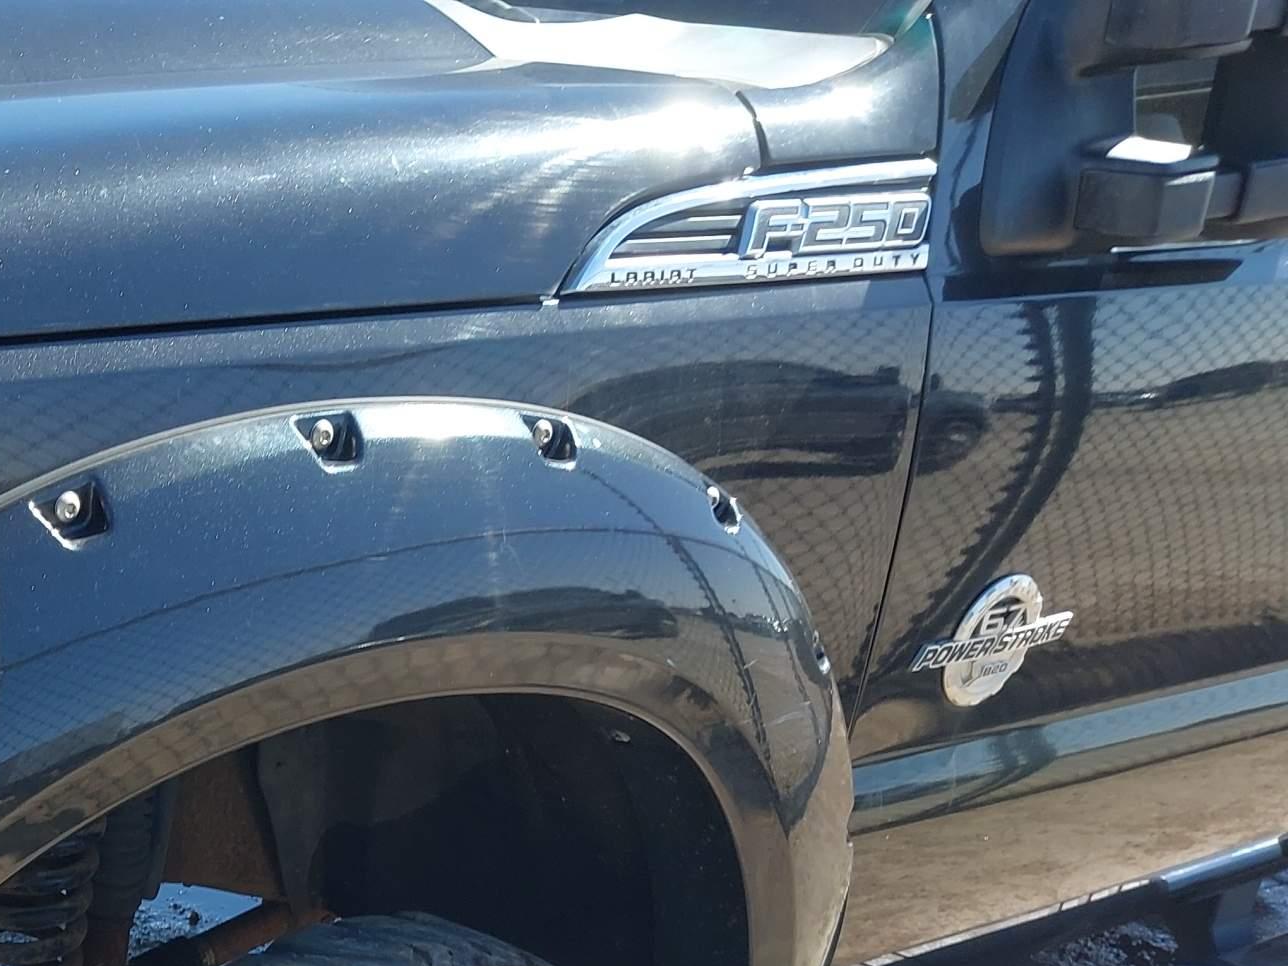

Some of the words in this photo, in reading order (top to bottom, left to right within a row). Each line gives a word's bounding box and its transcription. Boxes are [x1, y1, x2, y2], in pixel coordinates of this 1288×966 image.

[745, 196, 931, 256] F-250
[610, 268, 697, 286] LARIAT
[746, 258, 837, 277] SUPER
[853, 253, 920, 269] DUTY
